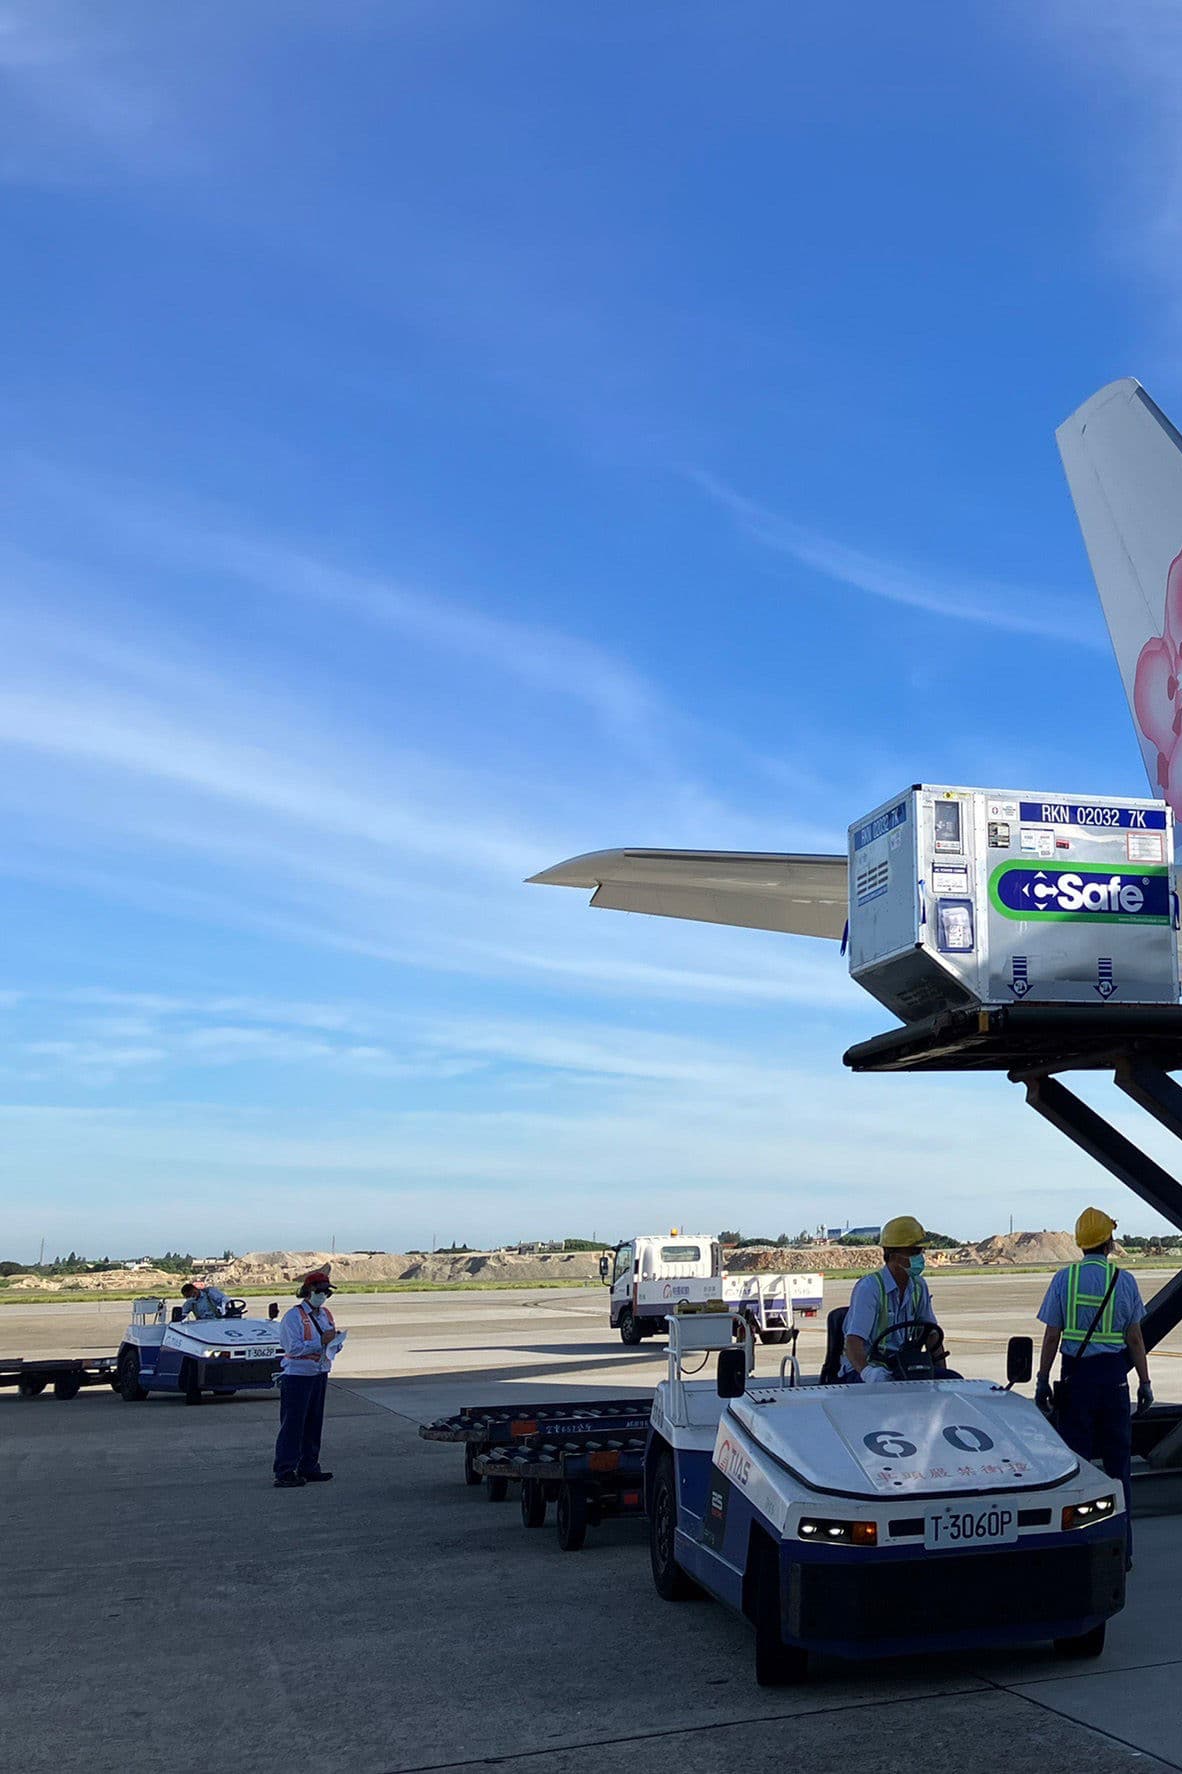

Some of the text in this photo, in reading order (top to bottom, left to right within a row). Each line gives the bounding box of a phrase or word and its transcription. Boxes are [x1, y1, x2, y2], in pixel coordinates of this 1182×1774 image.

[1042, 804, 1147, 828] RKN 02032 7K
[863, 1425, 994, 1459] 60
[729, 1448, 751, 1486] TIAS
[931, 1510, 1012, 1541] T-3060P
